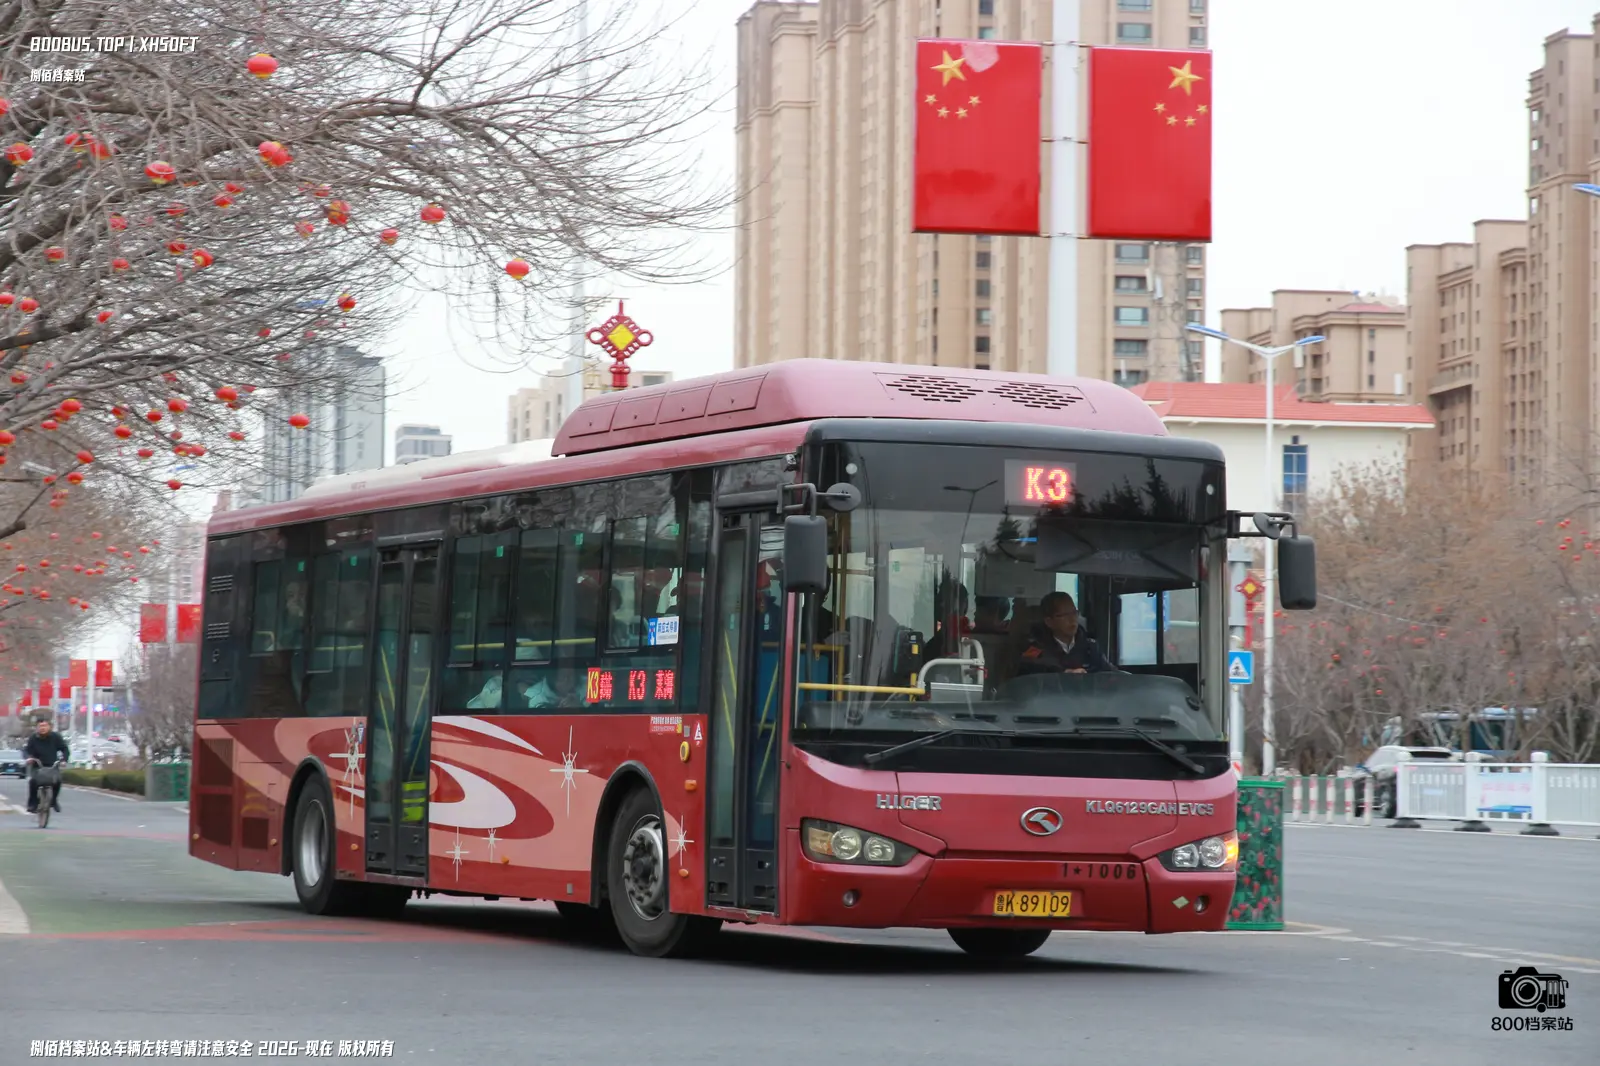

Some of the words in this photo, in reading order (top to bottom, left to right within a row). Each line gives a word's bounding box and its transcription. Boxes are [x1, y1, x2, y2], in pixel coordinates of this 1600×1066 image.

[1025, 467, 1068, 501] K3
[587, 671, 599, 699] K3
[628, 670, 646, 700] K3
[876, 793, 943, 811] HIGER
